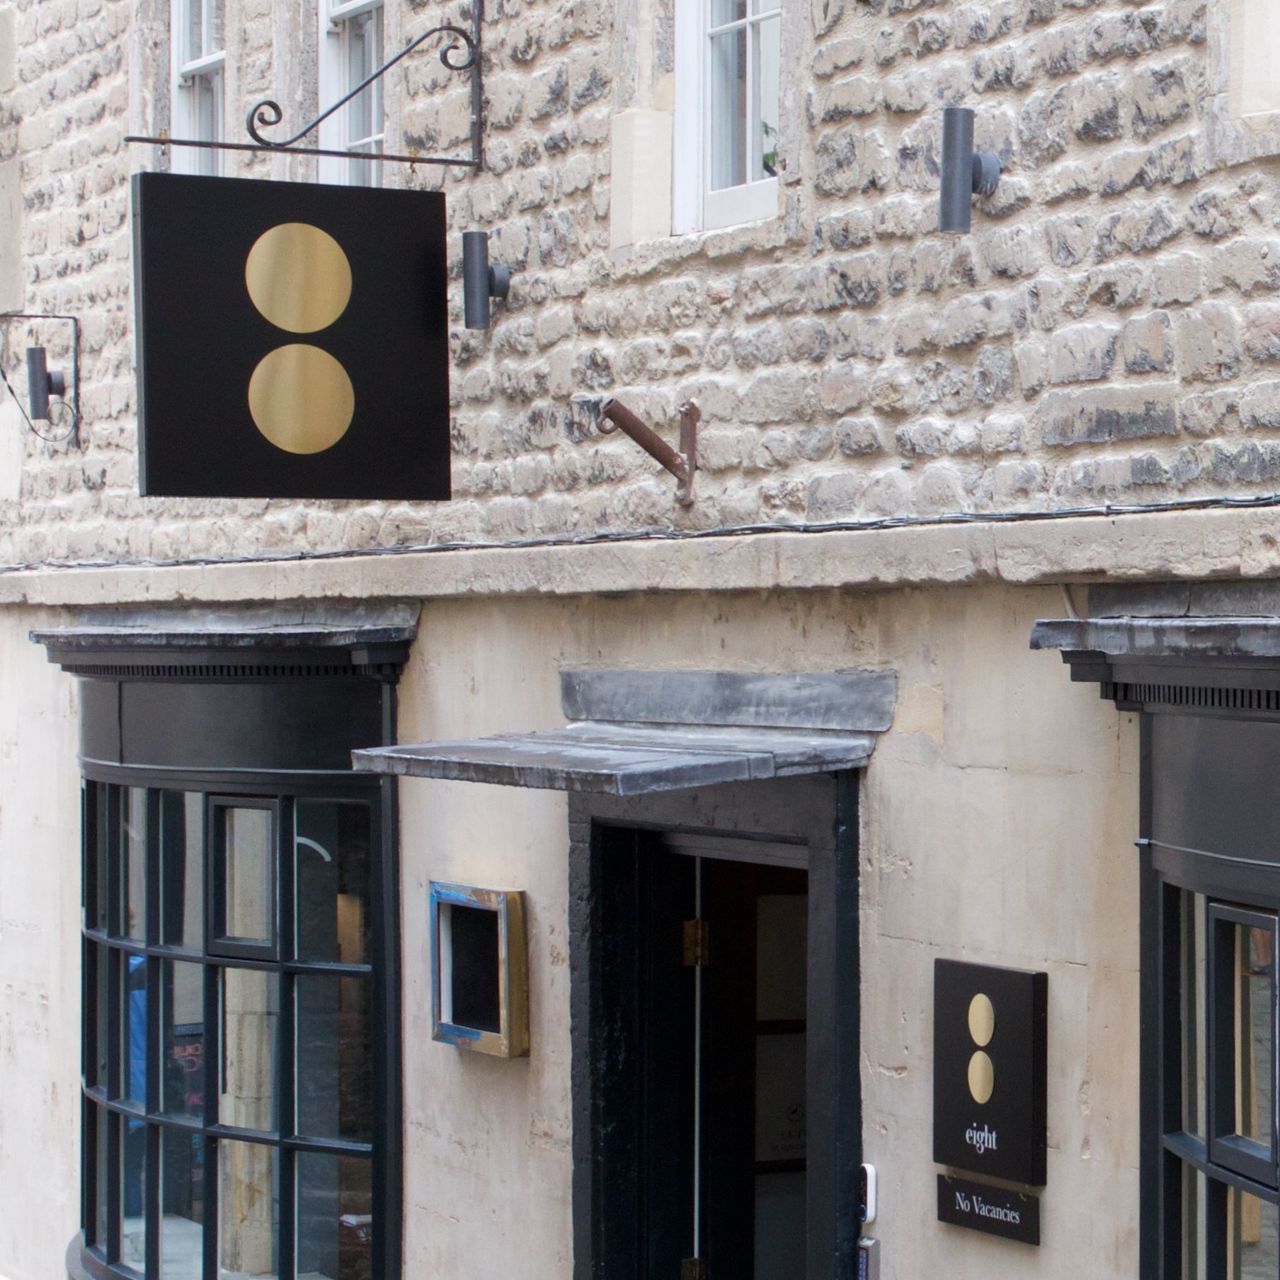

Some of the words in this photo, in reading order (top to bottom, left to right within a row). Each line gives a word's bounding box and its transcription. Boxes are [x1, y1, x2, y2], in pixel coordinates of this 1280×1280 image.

[965, 1122, 998, 1154] eight
[955, 1192, 971, 1212] No
[972, 1195, 1021, 1224] Vacancies
